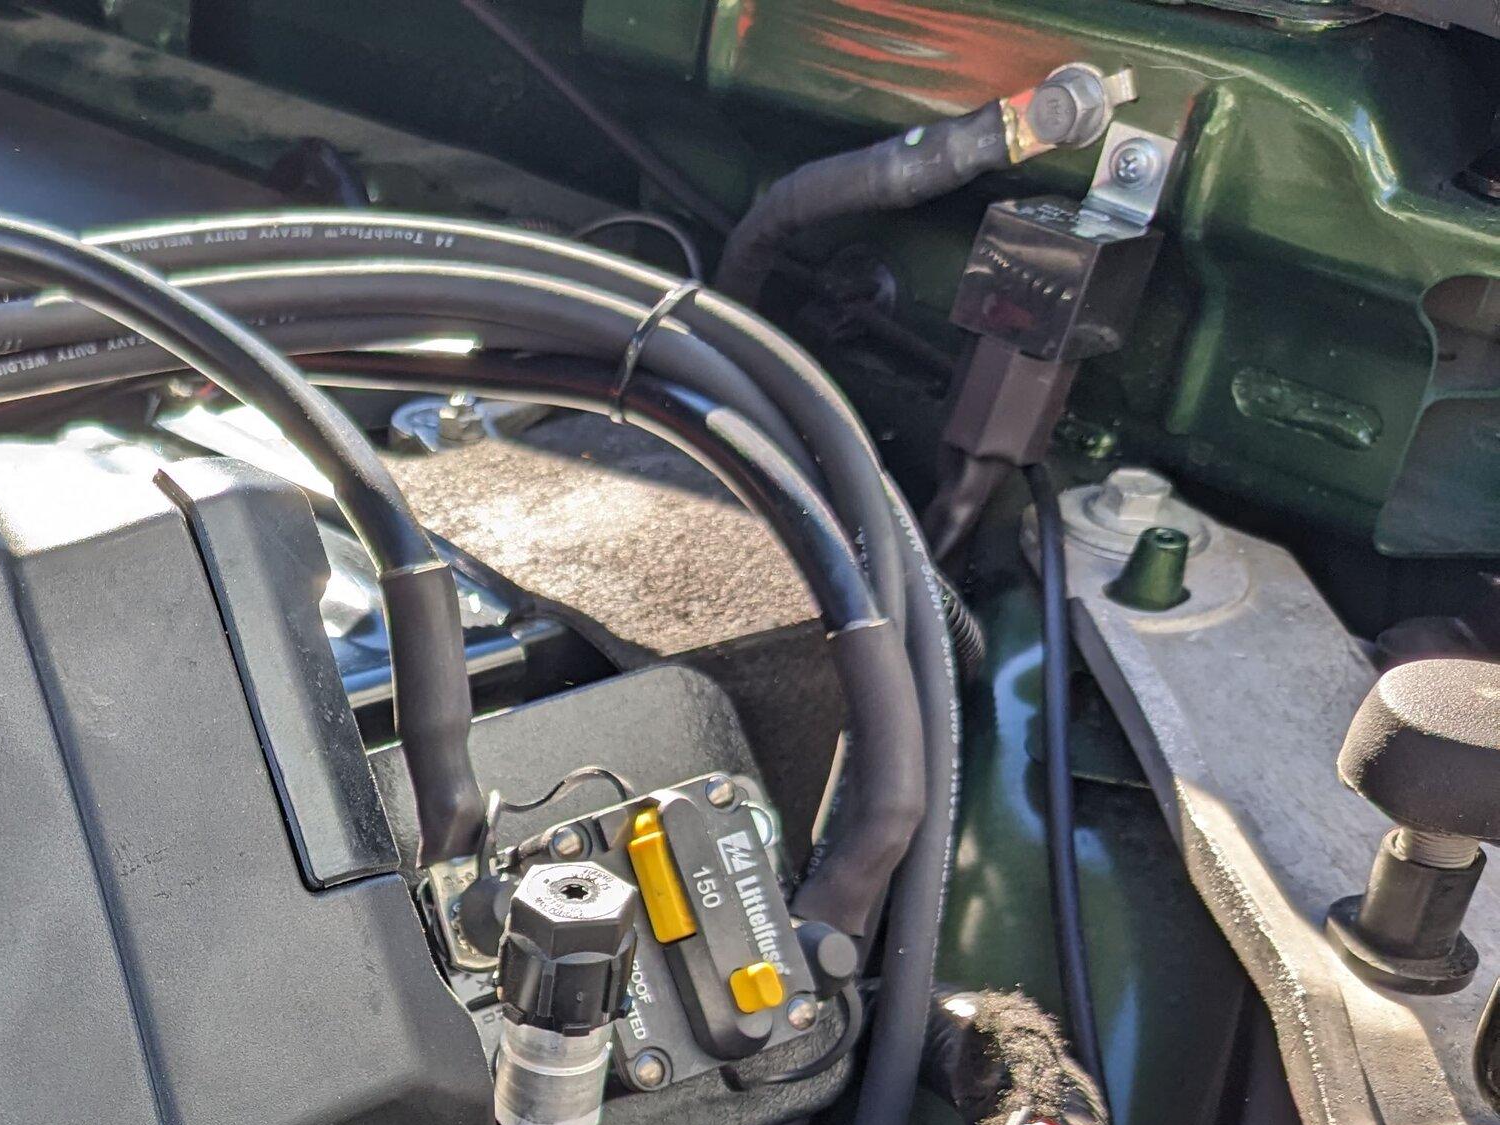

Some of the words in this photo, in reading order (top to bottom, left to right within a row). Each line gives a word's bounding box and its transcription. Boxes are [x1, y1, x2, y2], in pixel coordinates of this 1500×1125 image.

[204, 228, 249, 245] DUTY
[258, 225, 314, 240] HEAVY
[120, 233, 194, 254] WELDING
[56, 340, 98, 363] DUTY
[692, 866, 723, 909] 150
